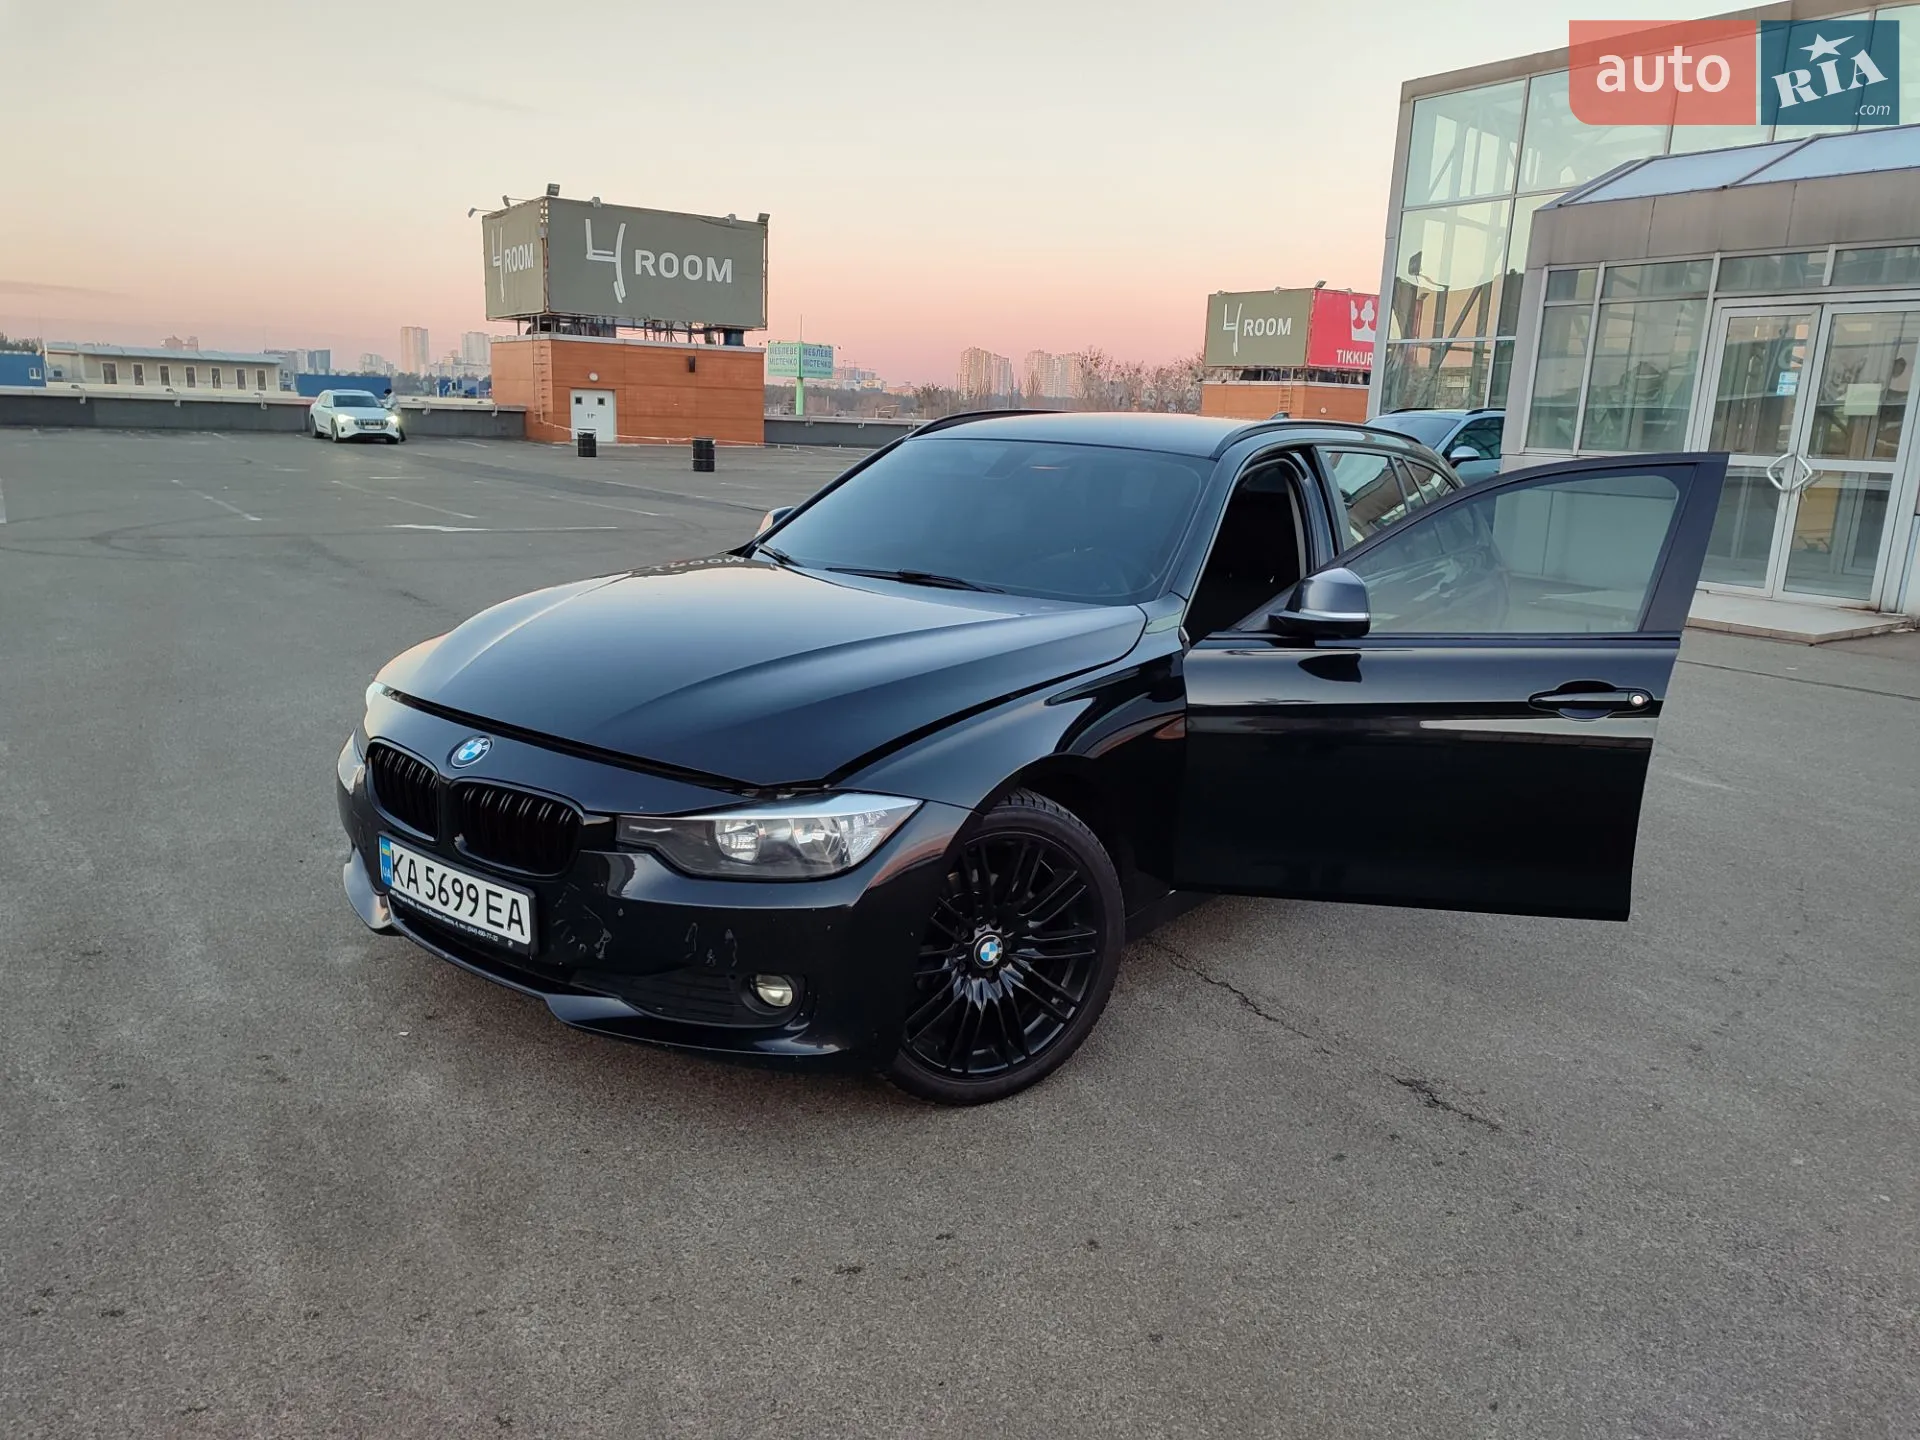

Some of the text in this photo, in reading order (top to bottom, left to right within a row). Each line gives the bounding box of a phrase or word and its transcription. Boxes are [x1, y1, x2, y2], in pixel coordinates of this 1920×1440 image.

[504, 242, 535, 274] ROOM
[635, 249, 733, 284] ROOM
[1243, 317, 1292, 337] ROOM
[391, 849, 420, 895] KA
[425, 865, 480, 918] 5699
[486, 889, 526, 937] EA
